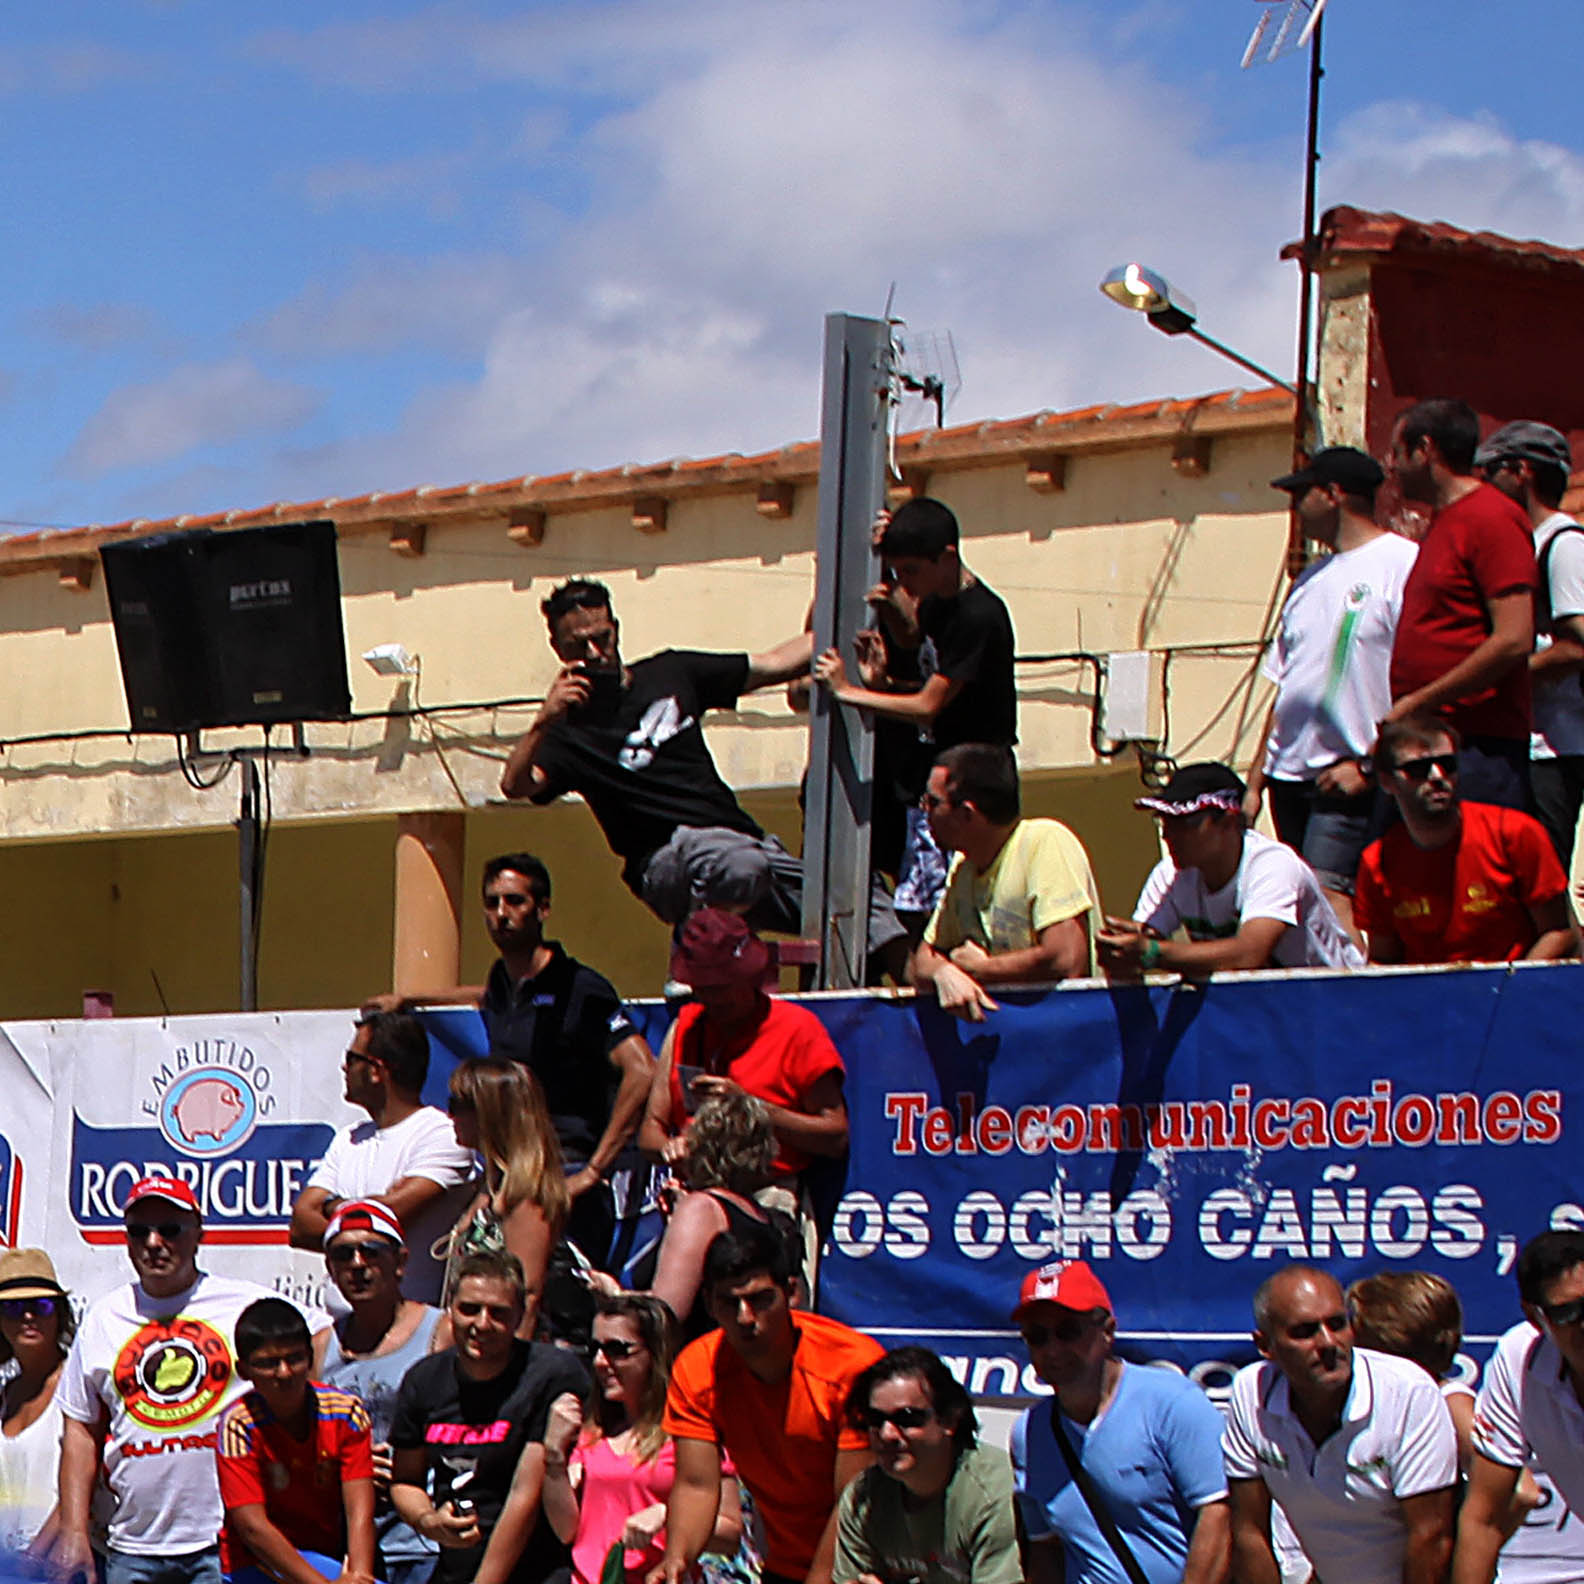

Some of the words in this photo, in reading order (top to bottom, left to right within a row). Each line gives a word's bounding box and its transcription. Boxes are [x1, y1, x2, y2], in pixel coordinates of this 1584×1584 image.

[141, 1038, 277, 1116] EMBUTIDOS
[884, 1080, 1563, 1156] Telecomunicaciones
[822, 1188, 930, 1261] OS
[953, 1189, 1172, 1262] OCHO
